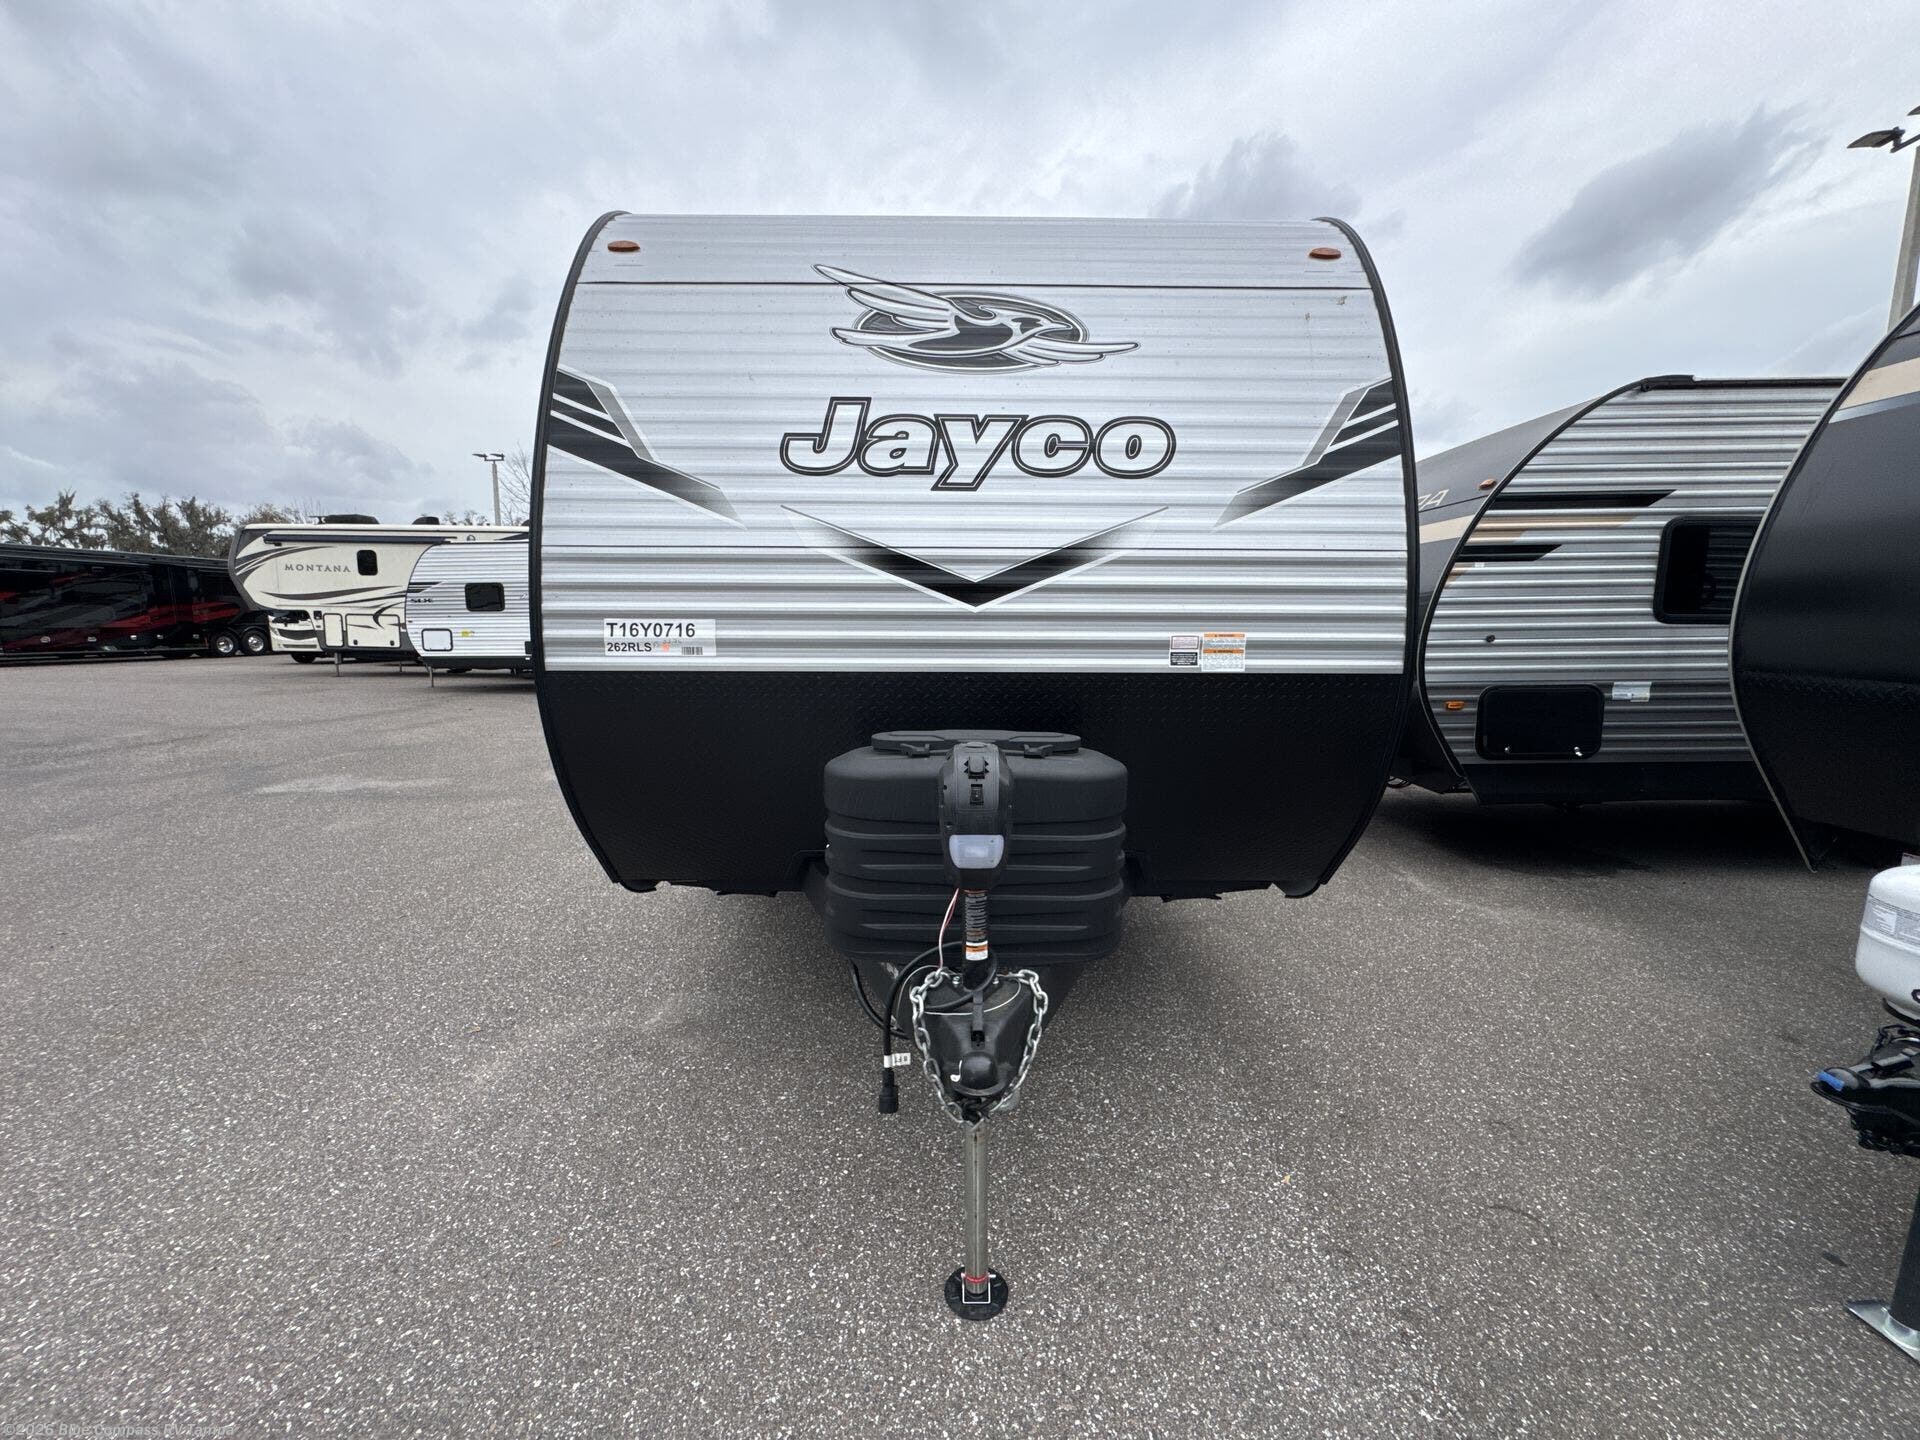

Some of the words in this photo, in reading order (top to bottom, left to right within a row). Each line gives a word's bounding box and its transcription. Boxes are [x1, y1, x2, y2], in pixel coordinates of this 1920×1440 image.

[779, 396, 1177, 491] Jayco
[284, 563, 352, 573] MONTANA
[606, 622, 696, 638] T16Y0716
[607, 642, 652, 652] 262RLS
